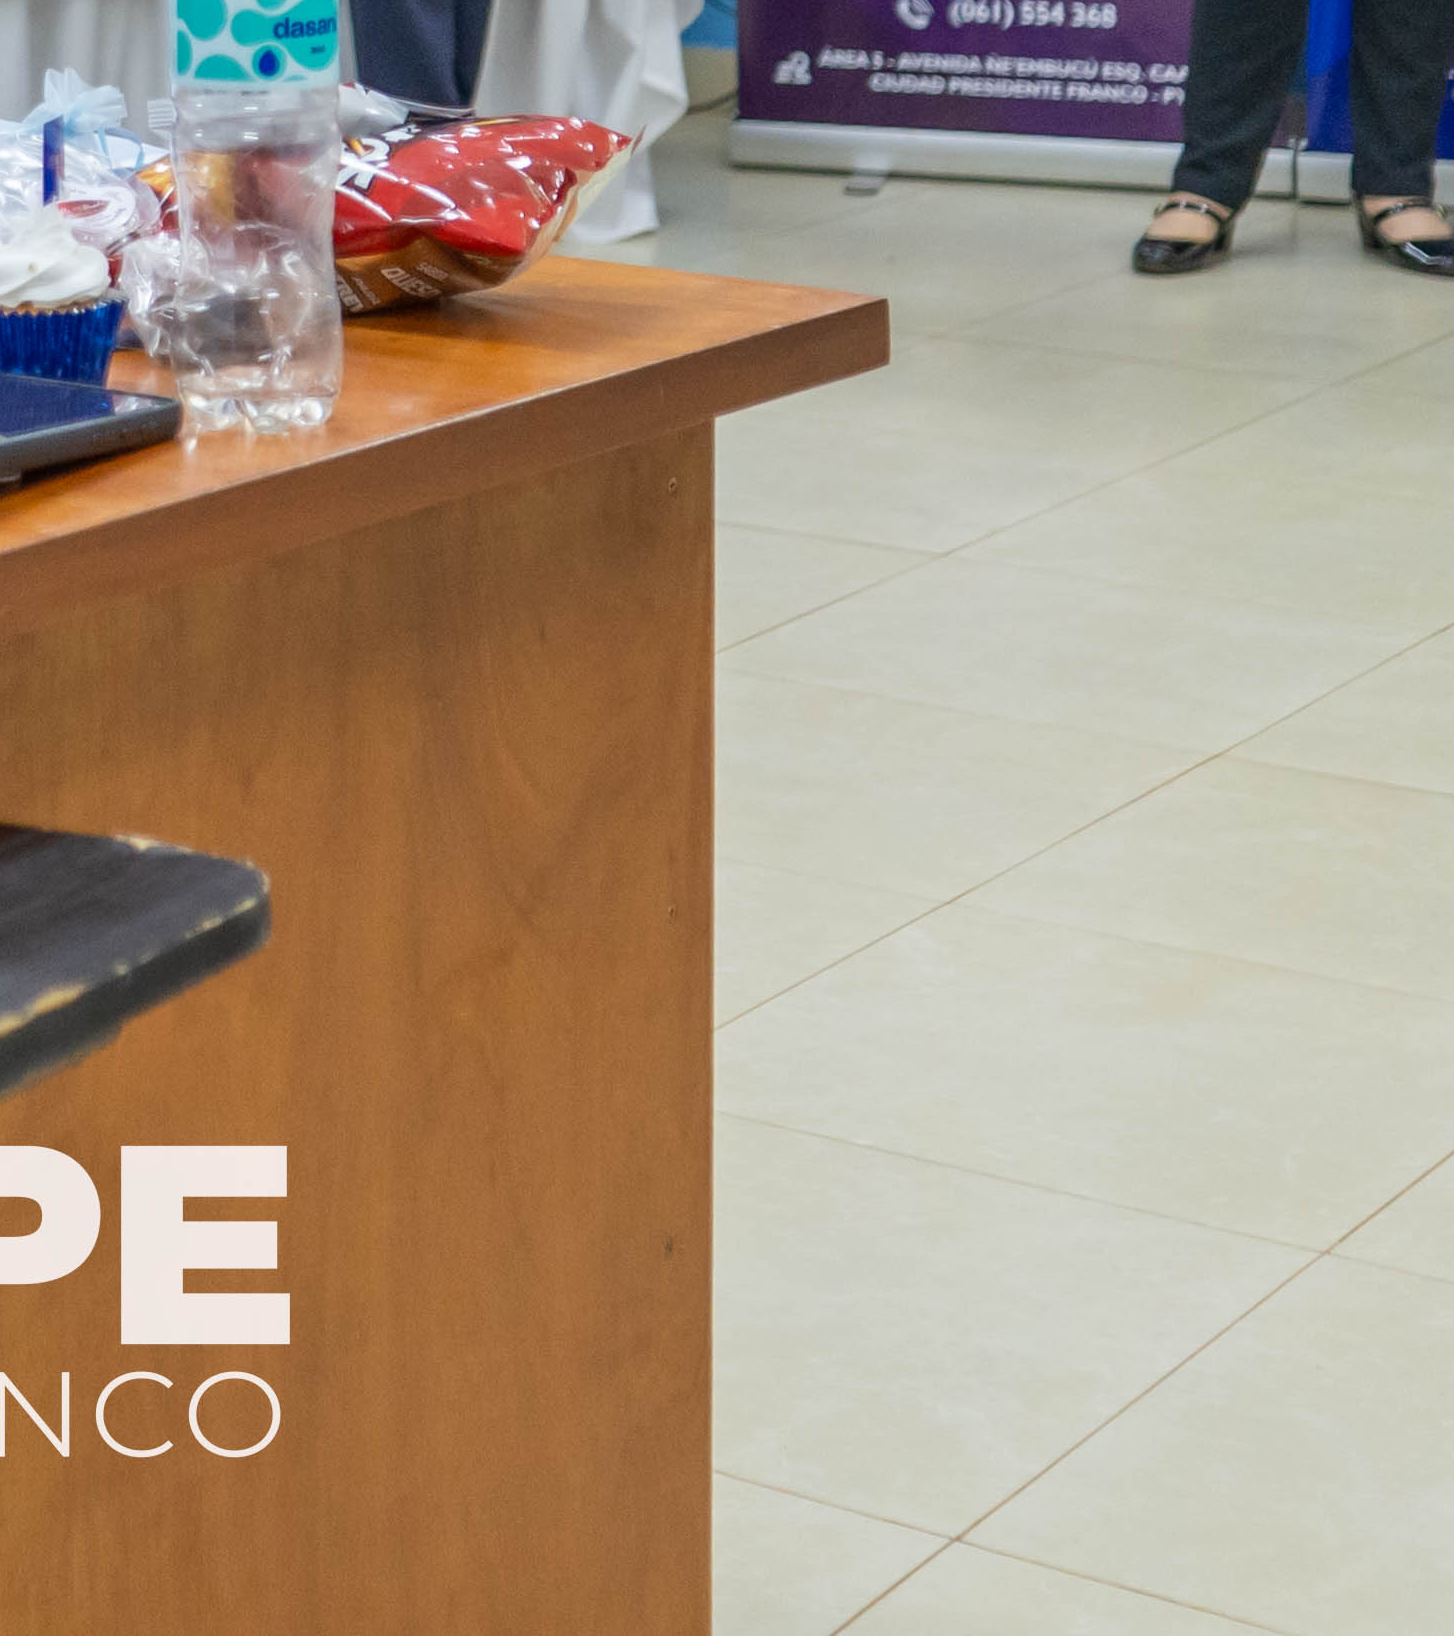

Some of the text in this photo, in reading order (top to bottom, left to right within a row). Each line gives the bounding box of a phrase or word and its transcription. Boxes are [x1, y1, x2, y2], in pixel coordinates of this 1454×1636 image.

[273, 17, 337, 39] dasan
[1018, 0, 1065, 27] 554
[1069, 1, 1117, 30] 368
[896, 52, 982, 73] AVENIDA
[868, 72, 946, 95] CIUDAD
[948, 75, 1064, 101] PRESIDENTE
[1066, 81, 1148, 104] FRANCO
